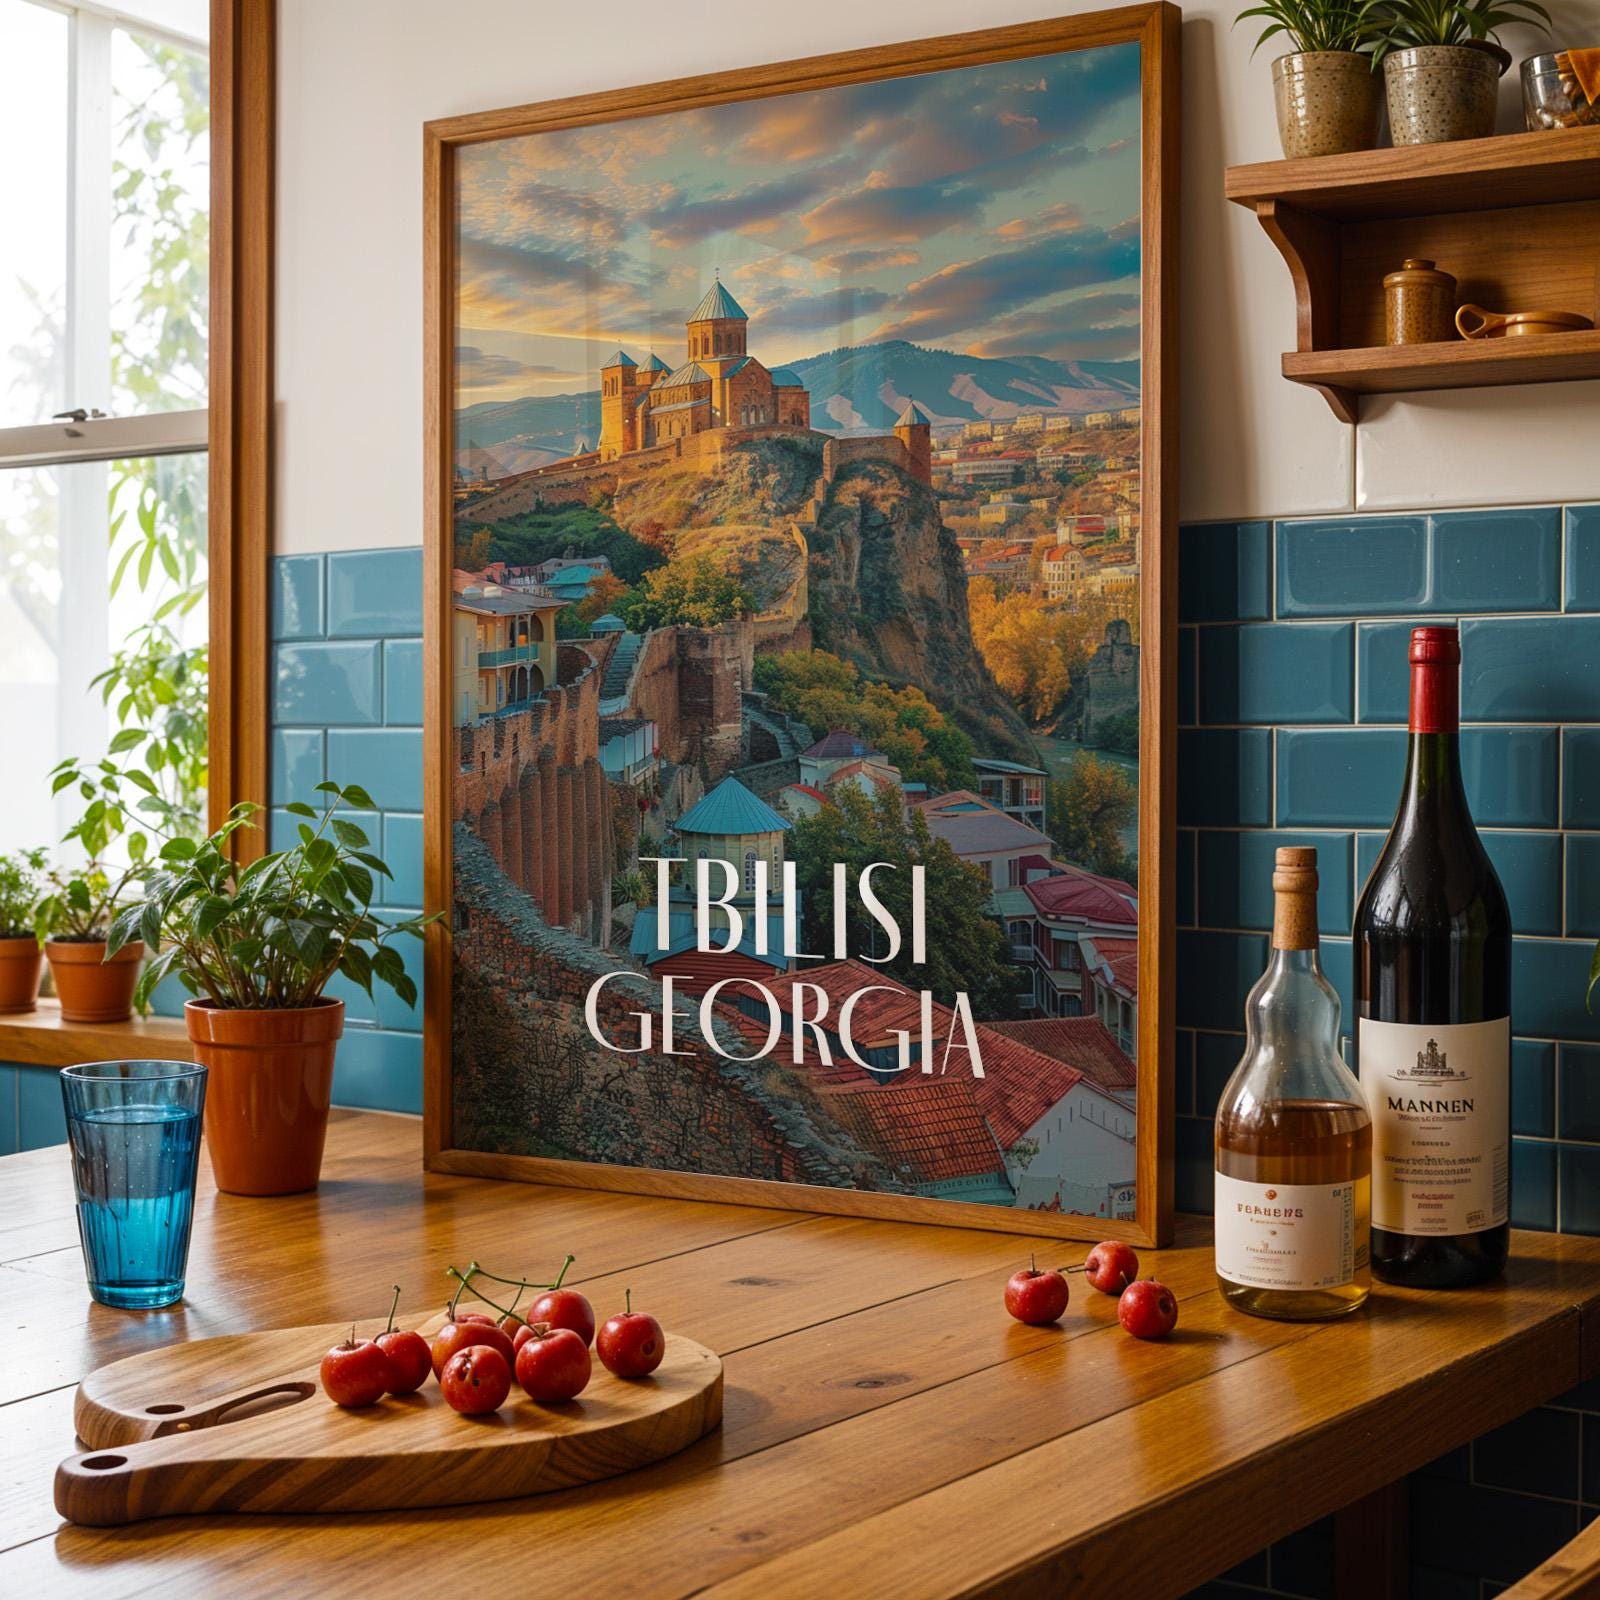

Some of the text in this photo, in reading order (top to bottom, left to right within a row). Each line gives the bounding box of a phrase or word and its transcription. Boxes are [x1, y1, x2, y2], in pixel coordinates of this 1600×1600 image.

[638, 857, 926, 964] TBILISI
[585, 971, 986, 1079] GEORGIA
[1388, 1096, 1474, 1113] MANNEN
